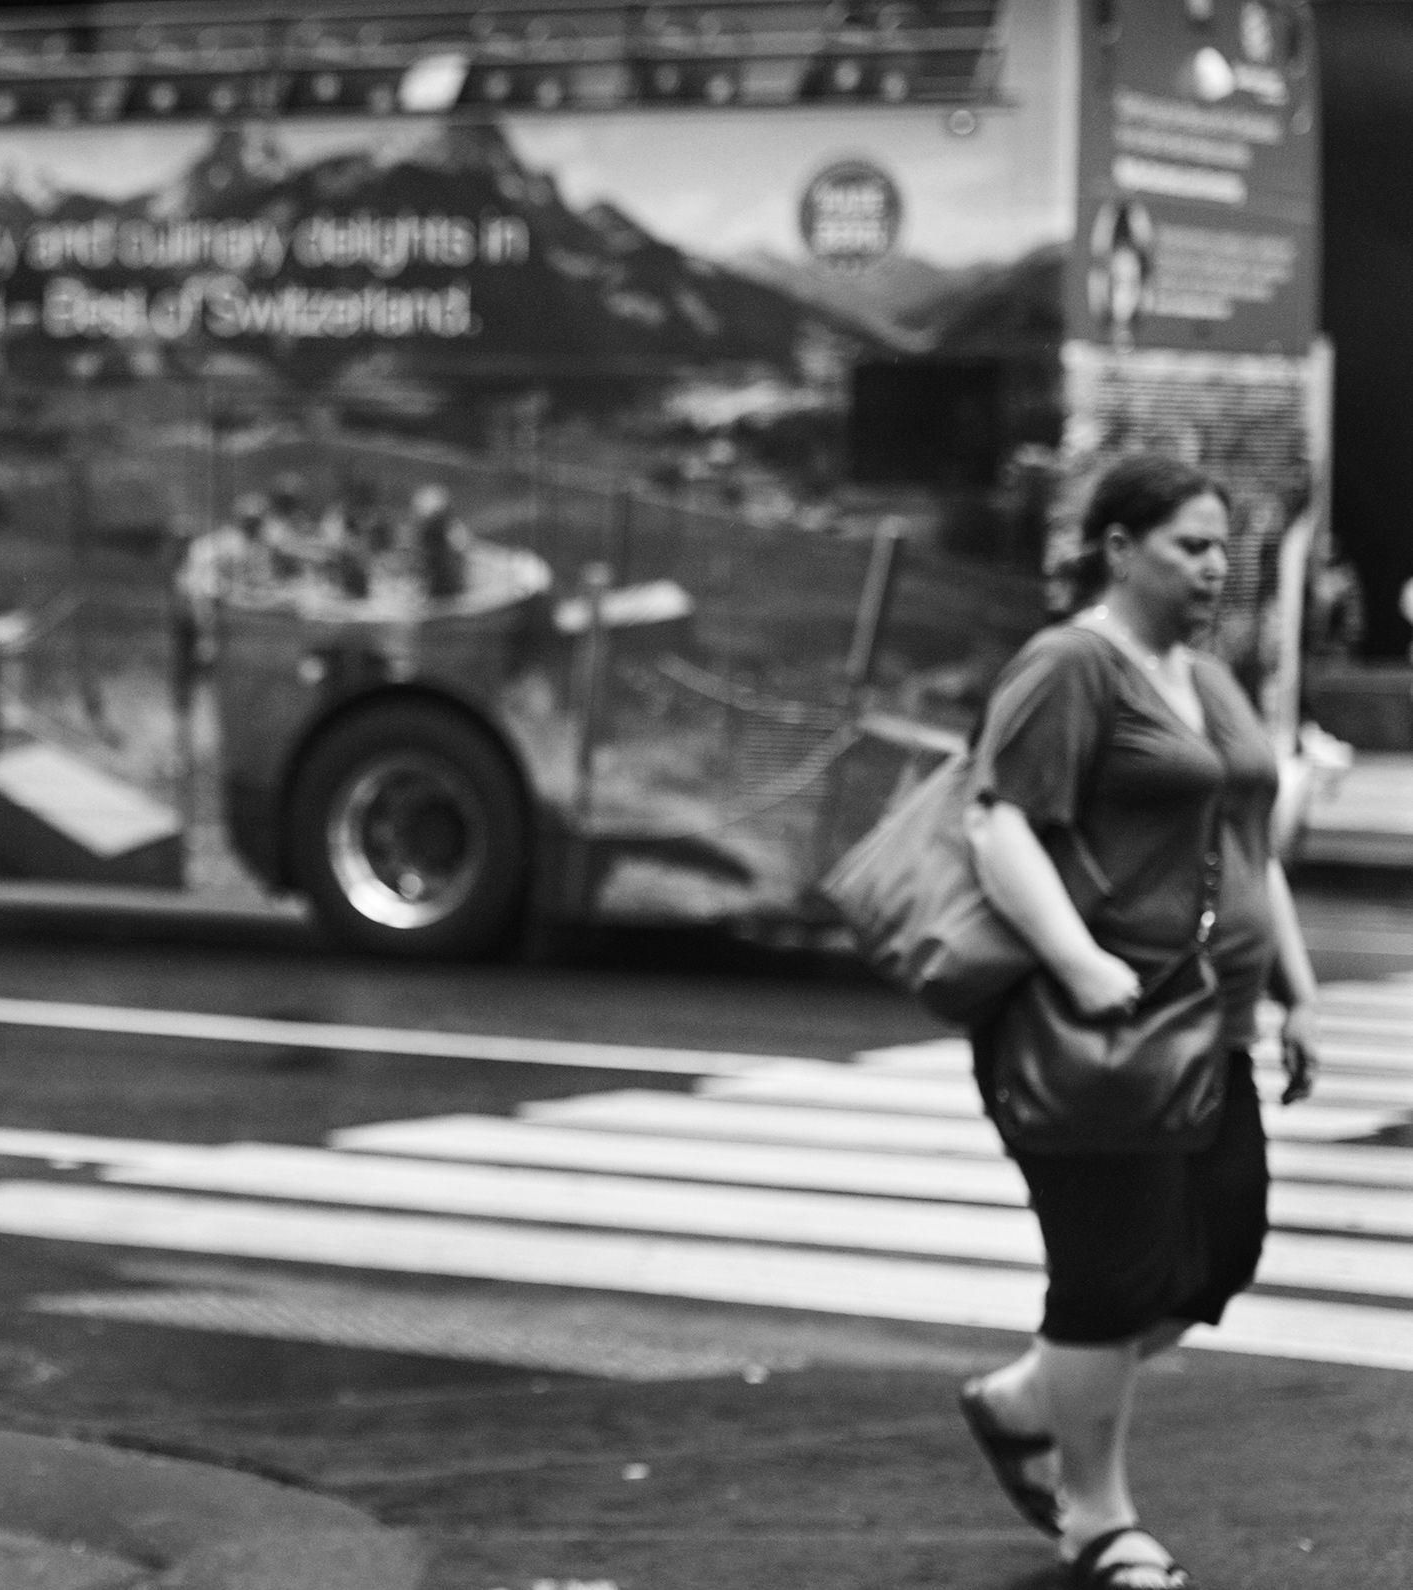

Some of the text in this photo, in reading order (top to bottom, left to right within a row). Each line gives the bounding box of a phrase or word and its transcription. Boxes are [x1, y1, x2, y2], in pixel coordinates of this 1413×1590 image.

[27, 217, 117, 270] and
[117, 217, 284, 279] culinary
[292, 212, 476, 279] delights
[480, 212, 530, 267] in
[43, 276, 147, 339] Best
[148, 274, 204, 339] of
